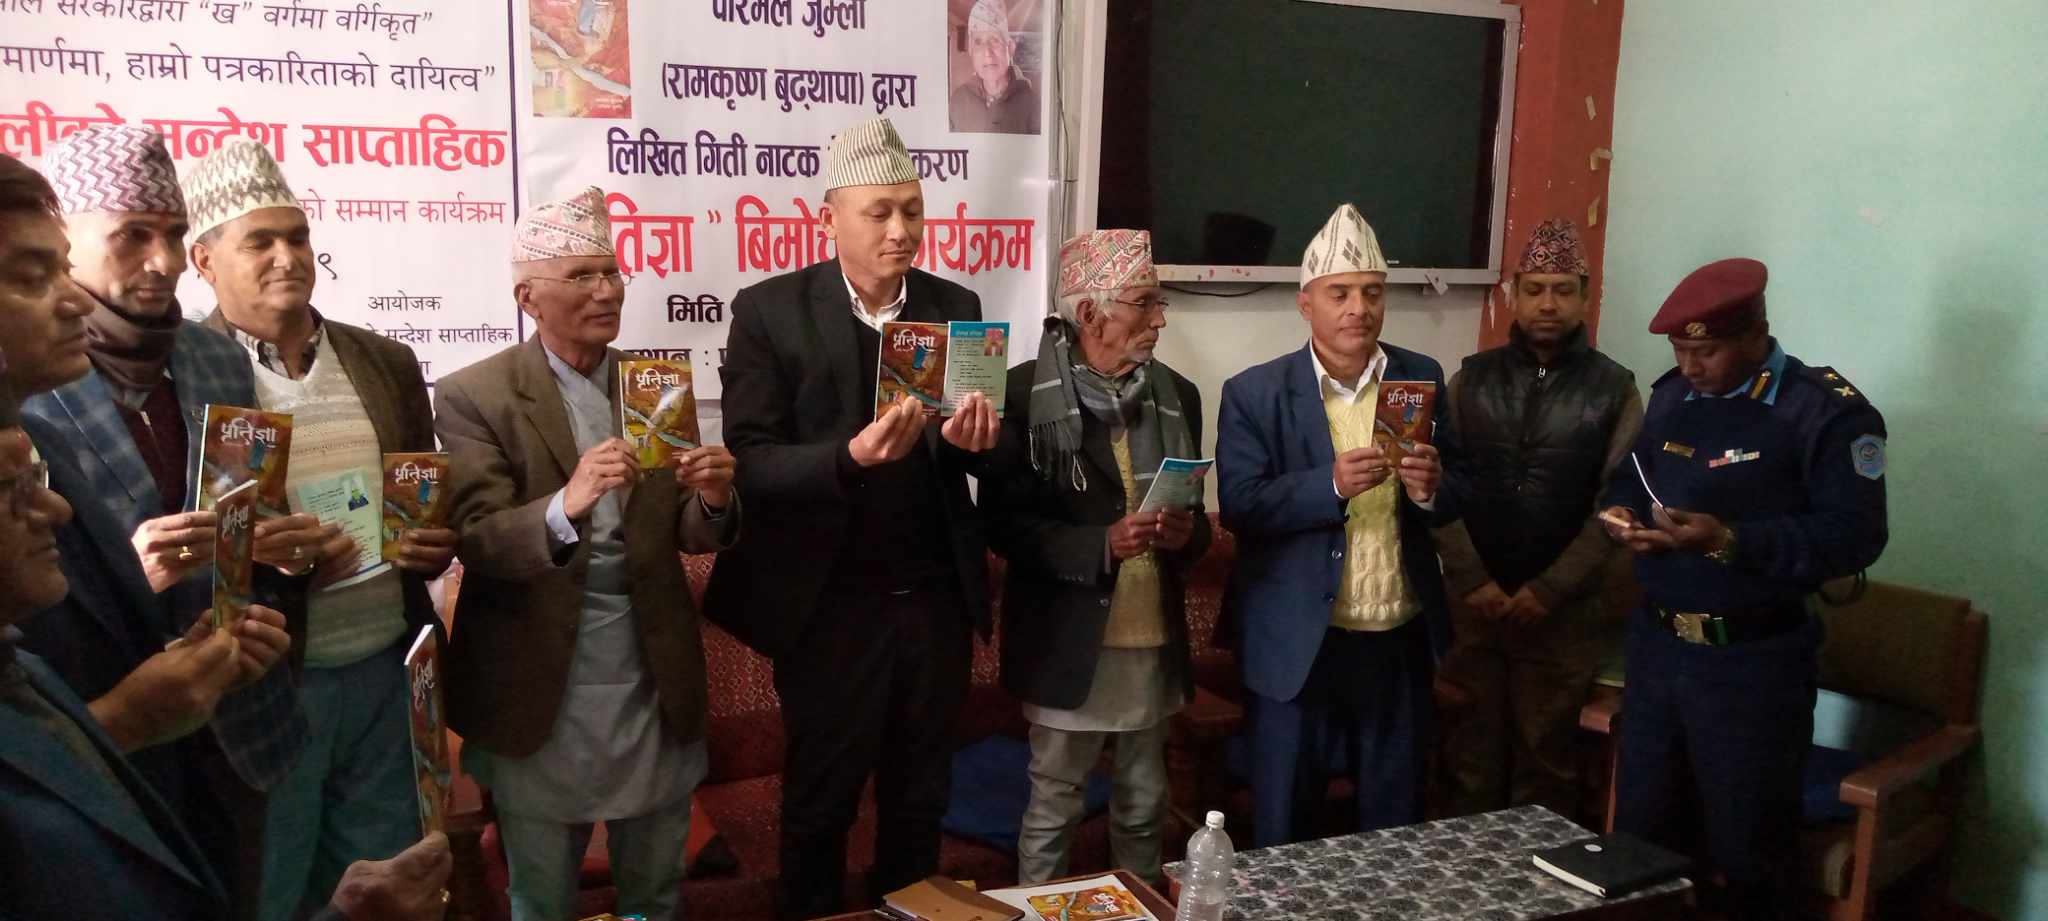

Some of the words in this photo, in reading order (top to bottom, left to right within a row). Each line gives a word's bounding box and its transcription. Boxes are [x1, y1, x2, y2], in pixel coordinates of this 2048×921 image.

[264, 0, 328, 29] वर्गमा
[126, 43, 192, 80] हाम्रो
[202, 51, 379, 88] पत्रकारिताको
[662, 62, 767, 111] (रामकृष्ण
[871, 73, 917, 114] द्वारा
[302, 114, 508, 168] साप्ताहिक
[607, 127, 688, 177] लिखित
[695, 130, 748, 178] गिती
[755, 144, 821, 177] नाटक
[336, 199, 409, 222] सम्मान
[418, 191, 506, 223] कार्यक्रम
[368, 290, 443, 311] आयोजक
[667, 294, 724, 323] मिति
[438, 323, 514, 344] साप्ताहिक
